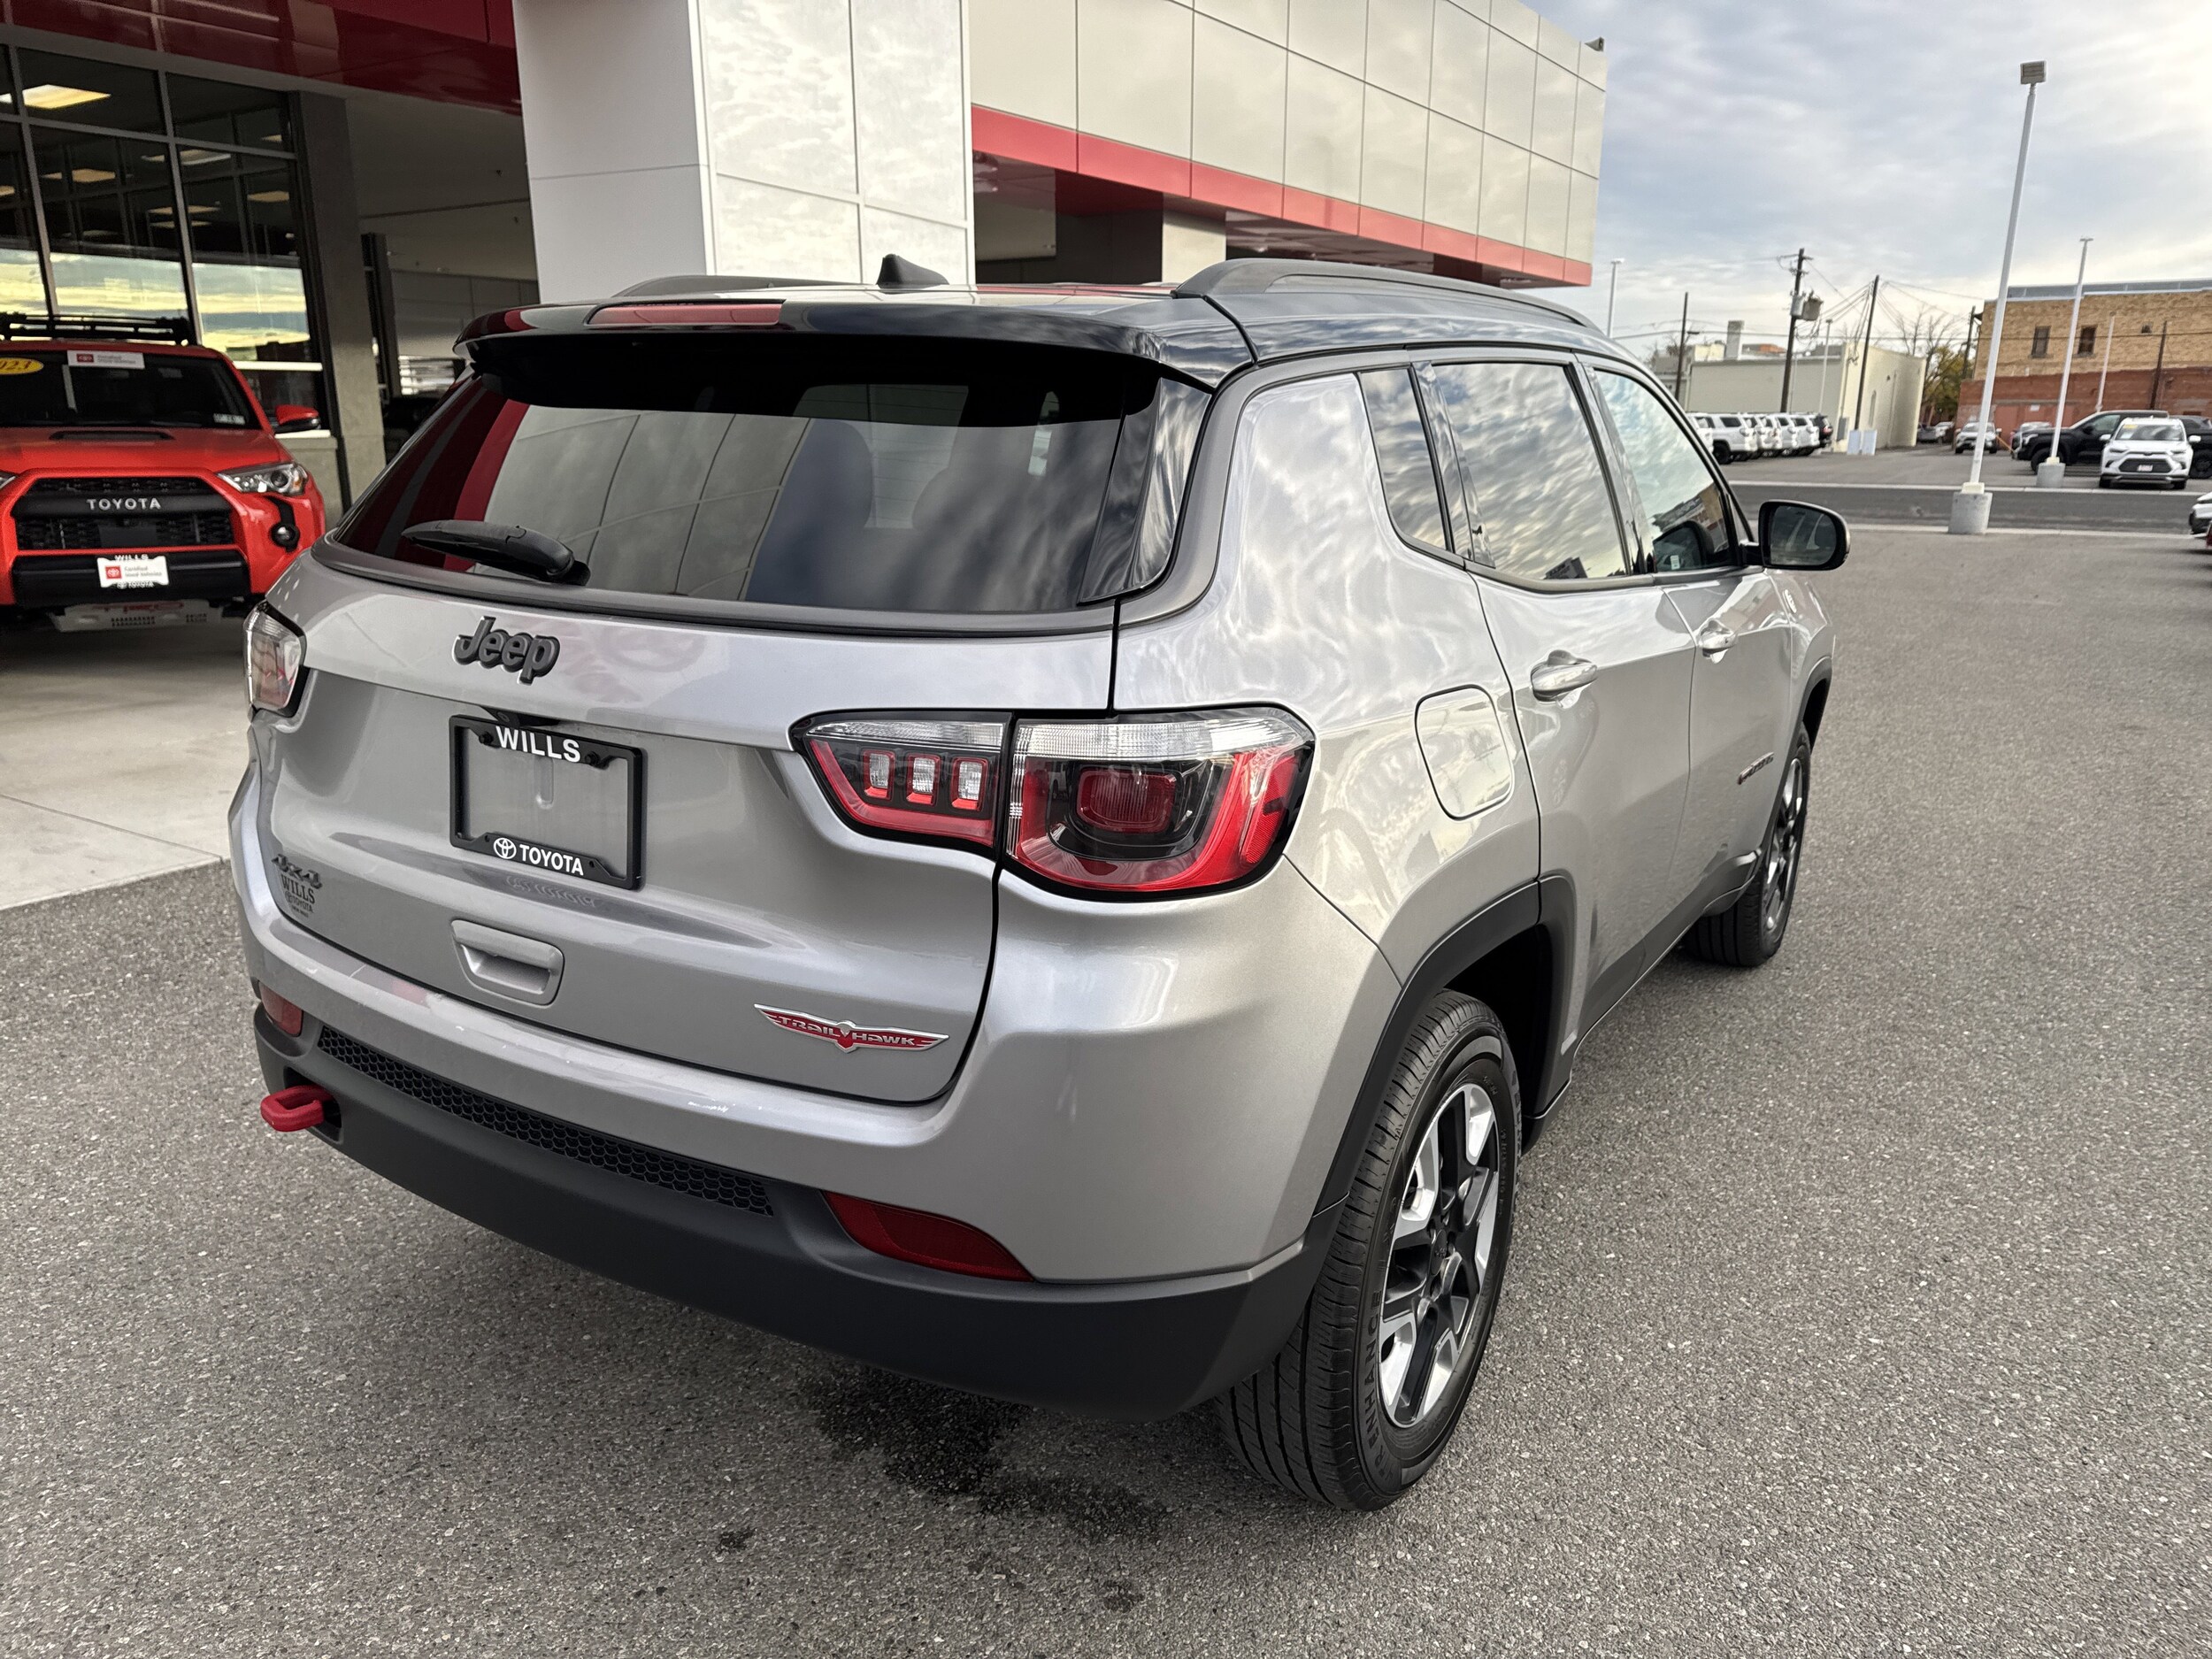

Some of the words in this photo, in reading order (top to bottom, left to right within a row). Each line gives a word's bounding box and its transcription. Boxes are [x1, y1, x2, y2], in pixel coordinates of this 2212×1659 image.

[87, 497, 161, 511] TOYOTA
[452, 616, 560, 685] Jeep
[495, 726, 581, 763] WILLS
[519, 843, 584, 876] TOYOTA
[280, 874, 316, 904] WILLS
[292, 895, 314, 914] TOYOTA
